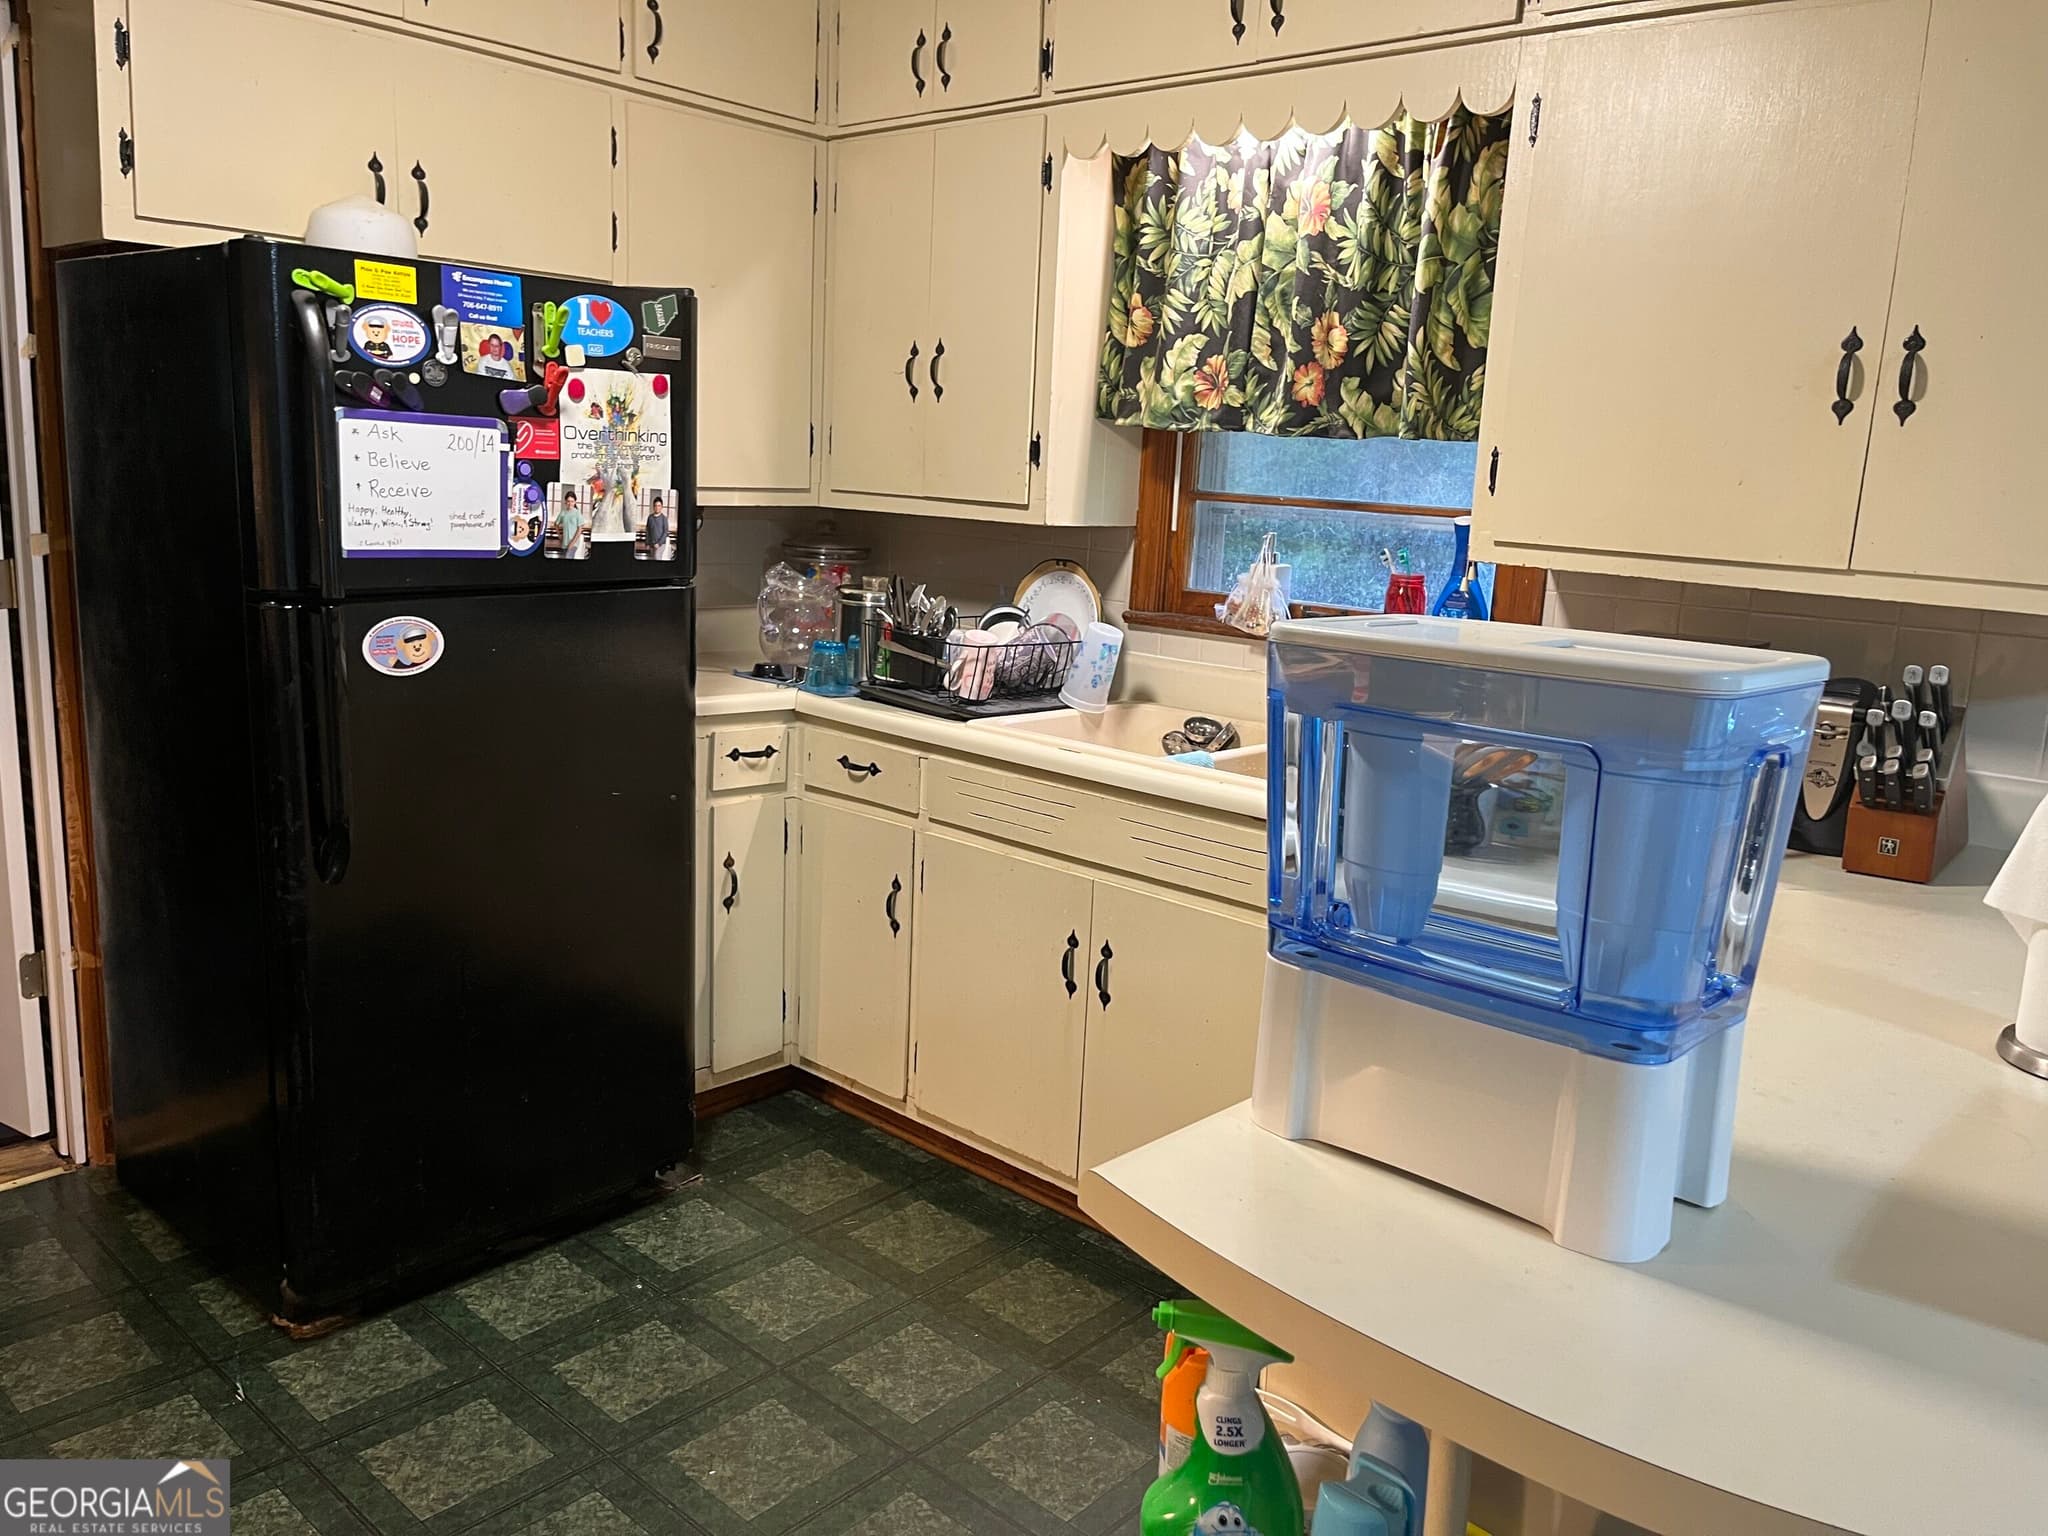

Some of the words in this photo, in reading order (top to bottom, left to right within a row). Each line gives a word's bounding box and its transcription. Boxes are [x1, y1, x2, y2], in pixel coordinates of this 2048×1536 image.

[577, 297, 592, 326] I
[392, 335, 421, 345] HOPE
[577, 327, 615, 337] TEACHERS
[367, 423, 404, 443] Ask
[563, 425, 668, 447] Overthinking
[447, 430, 495, 459] 200/14
[577, 442, 593, 450] the
[368, 451, 432, 471] Believe
[368, 479, 433, 499] Receive
[1215, 1415, 1242, 1425] CLINGS
[1216, 1425, 1244, 1437] 2.5X
